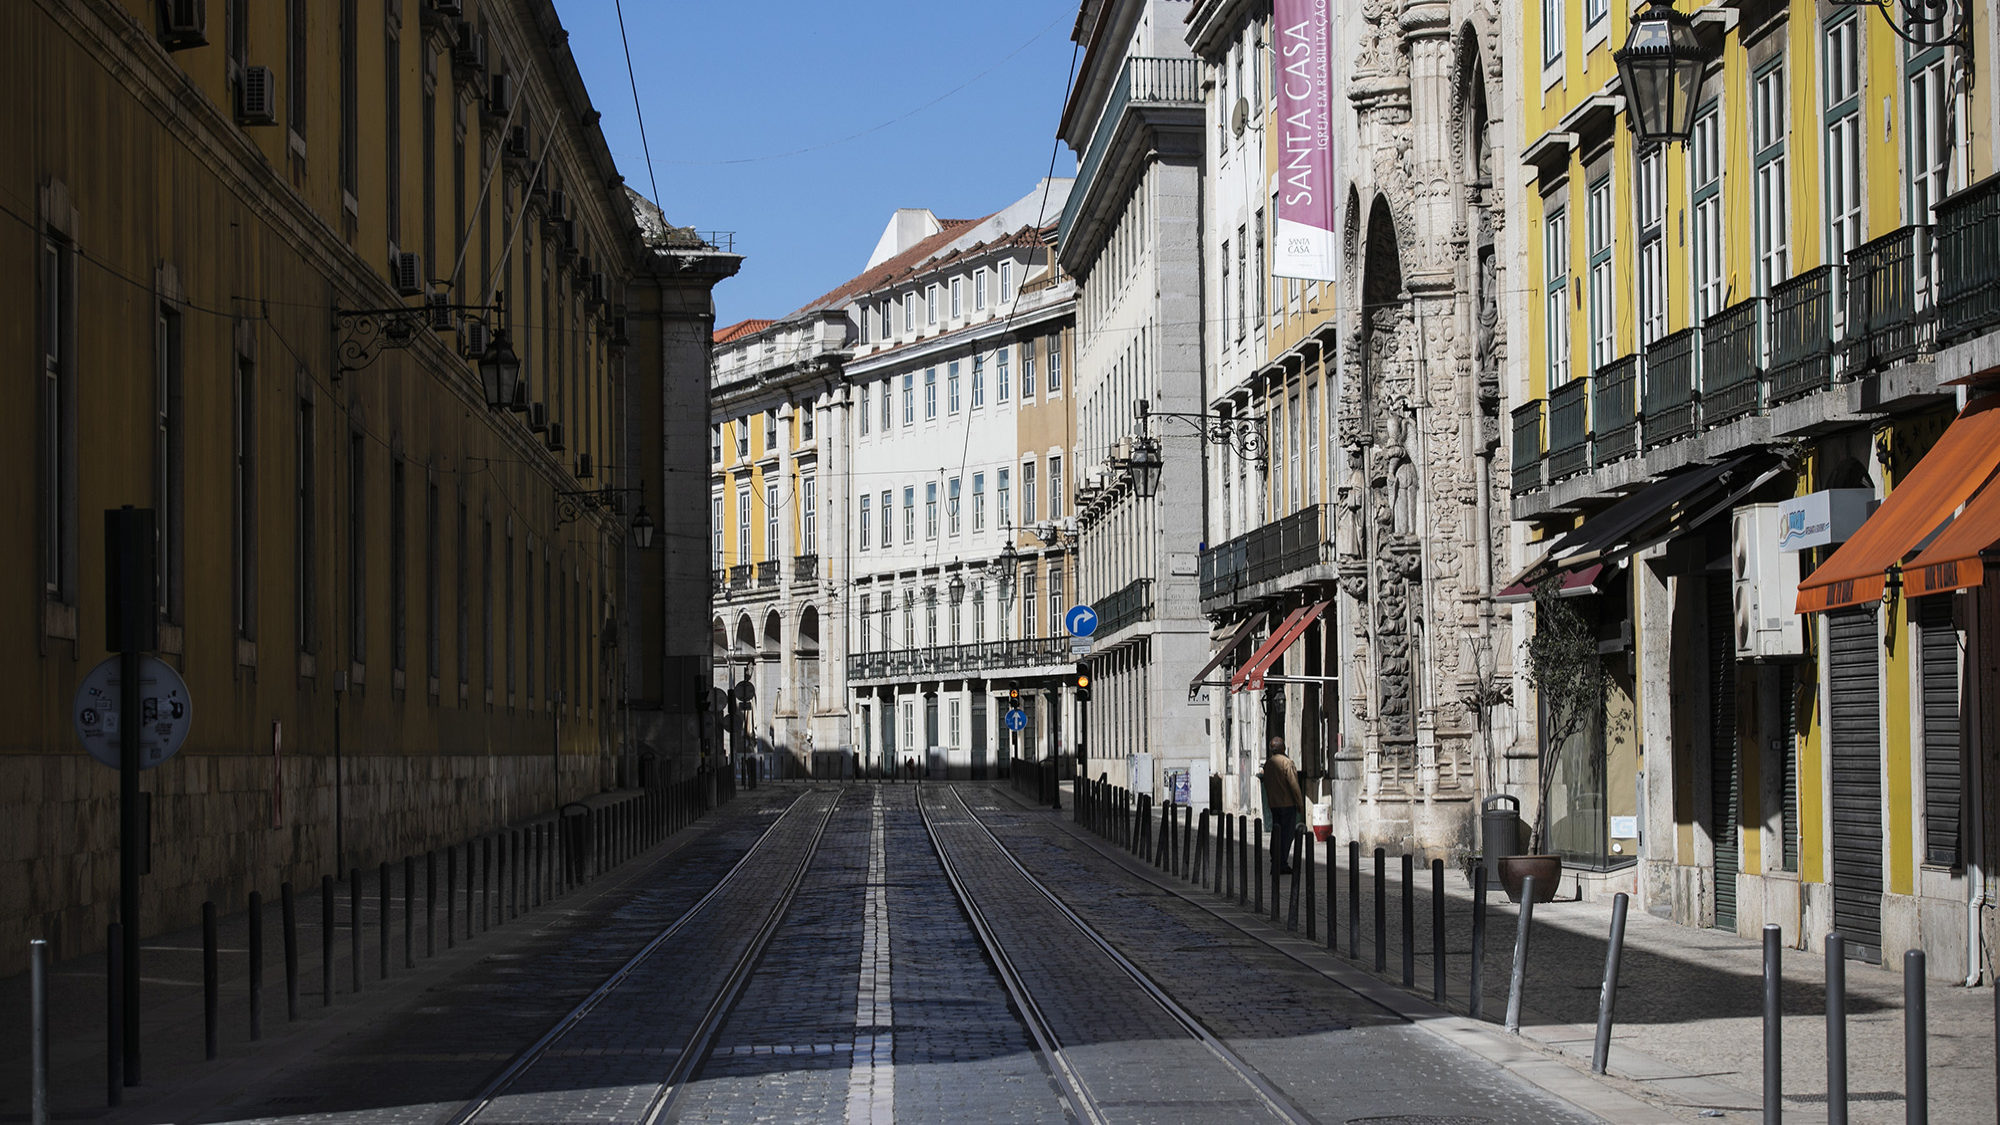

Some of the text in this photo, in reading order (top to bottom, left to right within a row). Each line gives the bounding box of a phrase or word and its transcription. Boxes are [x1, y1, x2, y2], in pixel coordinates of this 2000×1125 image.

[1283, 20, 1312, 206] SANTA CASA
[1314, 0, 1329, 150] IGREJA EM REABILITAÇÃO
[1287, 245, 1310, 254] CASA
[1288, 238, 1310, 246] SANTA
